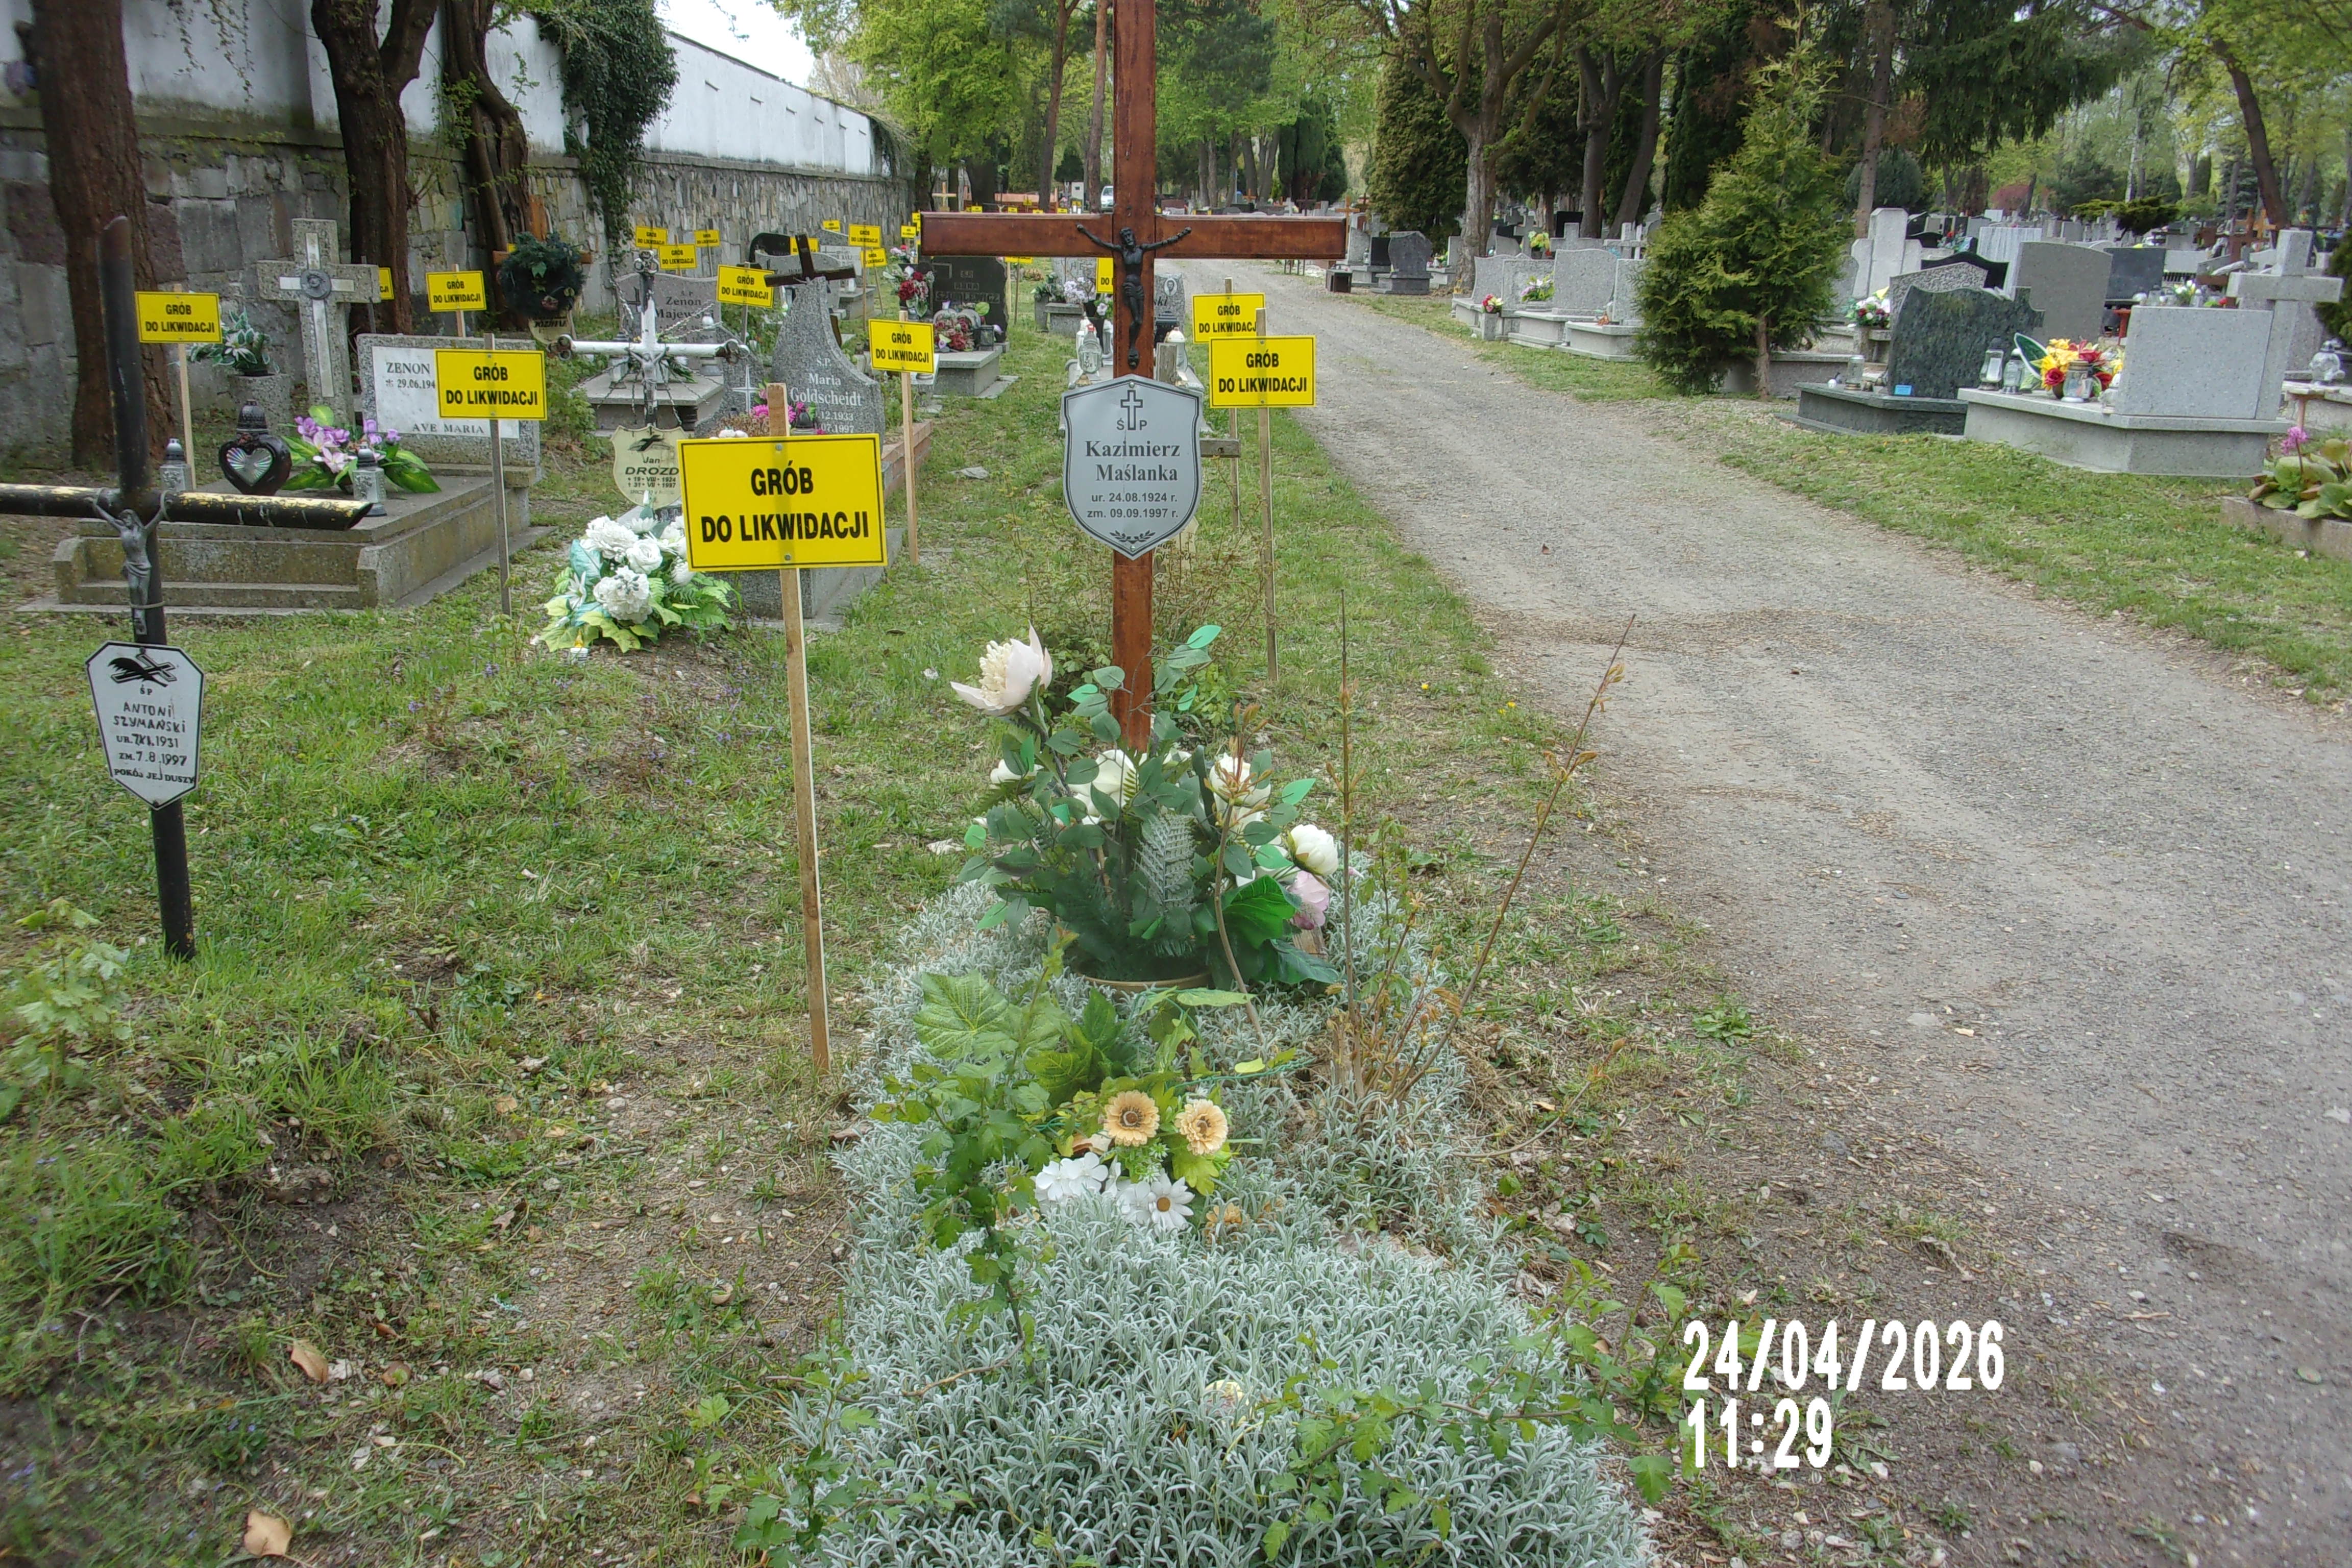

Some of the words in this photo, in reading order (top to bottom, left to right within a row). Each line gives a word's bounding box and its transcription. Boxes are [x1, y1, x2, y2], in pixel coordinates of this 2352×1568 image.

[447, 279, 464, 289] GRÓB
[737, 275, 754, 285] GRÓB
[1100, 277, 1109, 285] DO
[445, 293, 480, 302] LIKWIDACJI
[722, 287, 730, 295] DO
[732, 287, 768, 300] LIKWIDACJI
[666, 297, 701, 306] Zenon
[166, 302, 191, 315] GRÓB
[1218, 303, 1240, 316] GRÓB
[145, 321, 158, 332] DO
[162, 322, 215, 333] LIKWIDACJI
[1199, 323, 1210, 333] DO
[1213, 322, 1256, 332] LIKWIDACJ
[892, 331, 912, 344] GRÓB
[876, 348, 886, 359] DO
[888, 349, 929, 363] LIKWIDACJI
[1246, 349, 1279, 368] GRÓB
[386, 362, 430, 374] ZENON
[474, 363, 508, 381] GRÓB
[397, 379, 435, 389] 29.06.194
[808, 373, 841, 385] Maria
[1219, 378, 1235, 393] DO
[1239, 377, 1307, 393] LIKWIDACJI
[446, 390, 463, 404] DO
[468, 390, 537, 405] LIKWIDACJI
[790, 387, 862, 406] Goldscheidt
[413, 423, 437, 432] AVE
[444, 424, 484, 434] MARIA
[1117, 418, 1124, 431] Ś
[1139, 420, 1147, 431] P
[1085, 440, 1180, 457] Kazimierz
[625, 467, 679, 475] DROZD
[1095, 463, 1178, 481] Maślanka
[751, 460, 814, 496] GRÓB
[1091, 494, 1105, 502] ur.
[1109, 493, 1167, 502] 24.08.1924
[1171, 494, 1178, 502] r.
[1087, 510, 1106, 518] zm.
[1110, 508, 1168, 518] 09.09.1997
[1172, 510, 1179, 518] r.
[701, 515, 732, 543] DO
[740, 511, 869, 541] LIKWIDACJI
[165, 774, 195, 784] DUSZY
